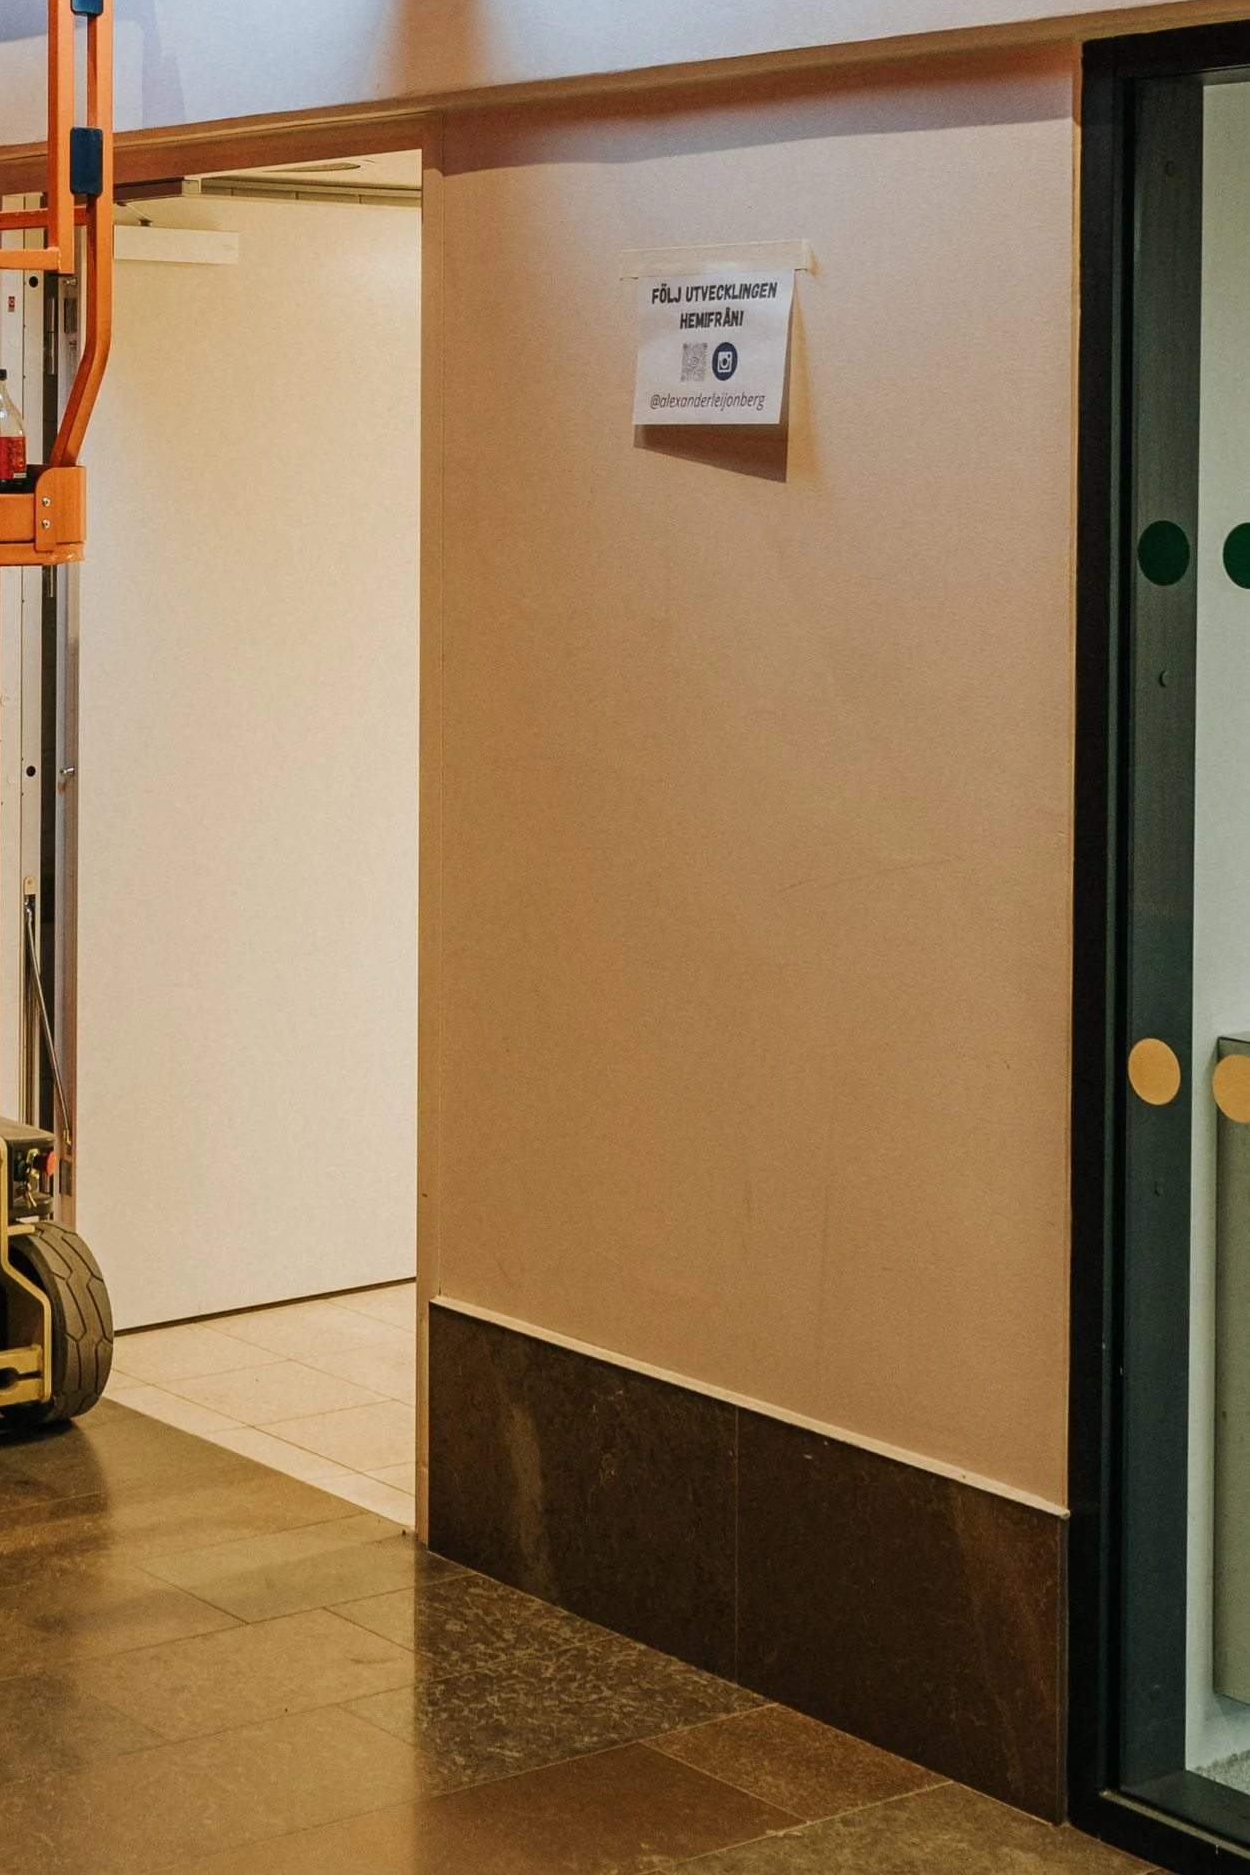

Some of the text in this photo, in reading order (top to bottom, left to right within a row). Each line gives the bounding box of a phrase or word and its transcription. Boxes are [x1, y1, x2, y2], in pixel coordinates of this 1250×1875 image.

[651, 281, 778, 304] FÖLJ UTVECKLINGEN
[650, 392, 766, 412] @alexanderleijonberg
